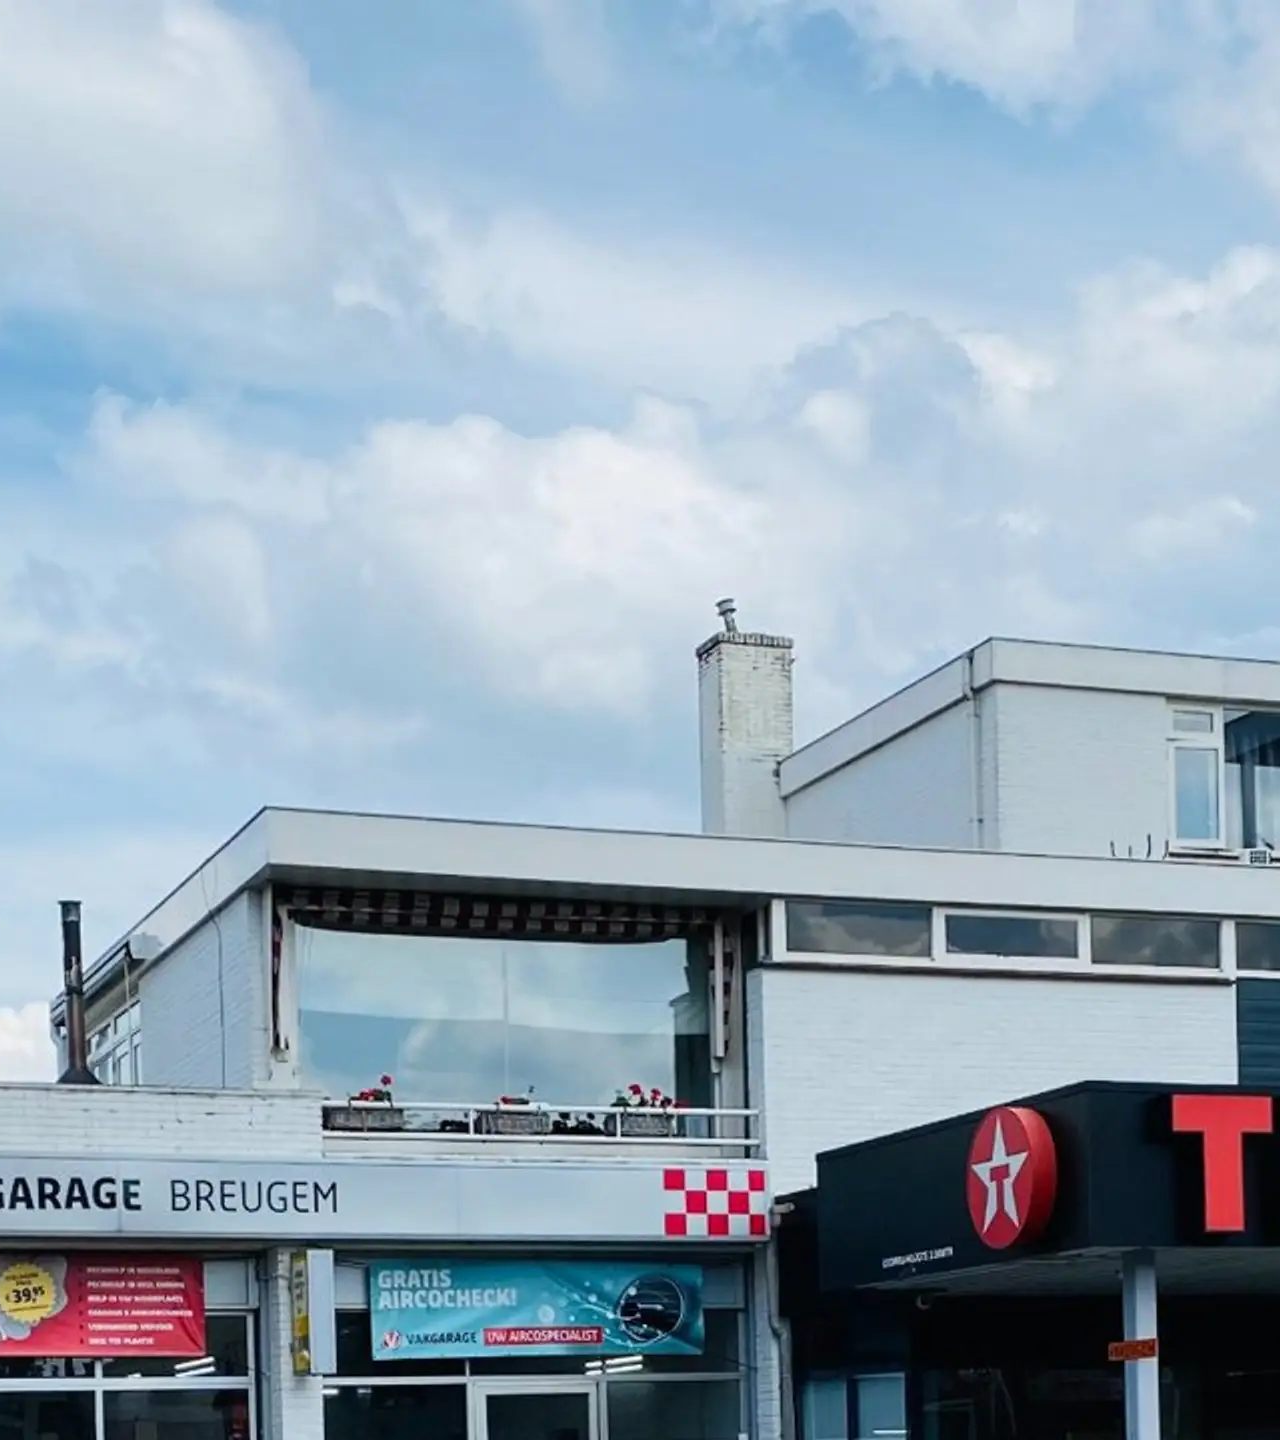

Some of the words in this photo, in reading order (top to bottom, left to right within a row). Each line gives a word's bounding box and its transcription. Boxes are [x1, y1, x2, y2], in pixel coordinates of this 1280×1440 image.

[170, 1179, 338, 1213] BREUGEM
[378, 1269, 451, 1289] GRATIS
[378, 1287, 517, 1310] AIRCOCHECK!
[405, 1331, 477, 1345] VAKGARAGE
